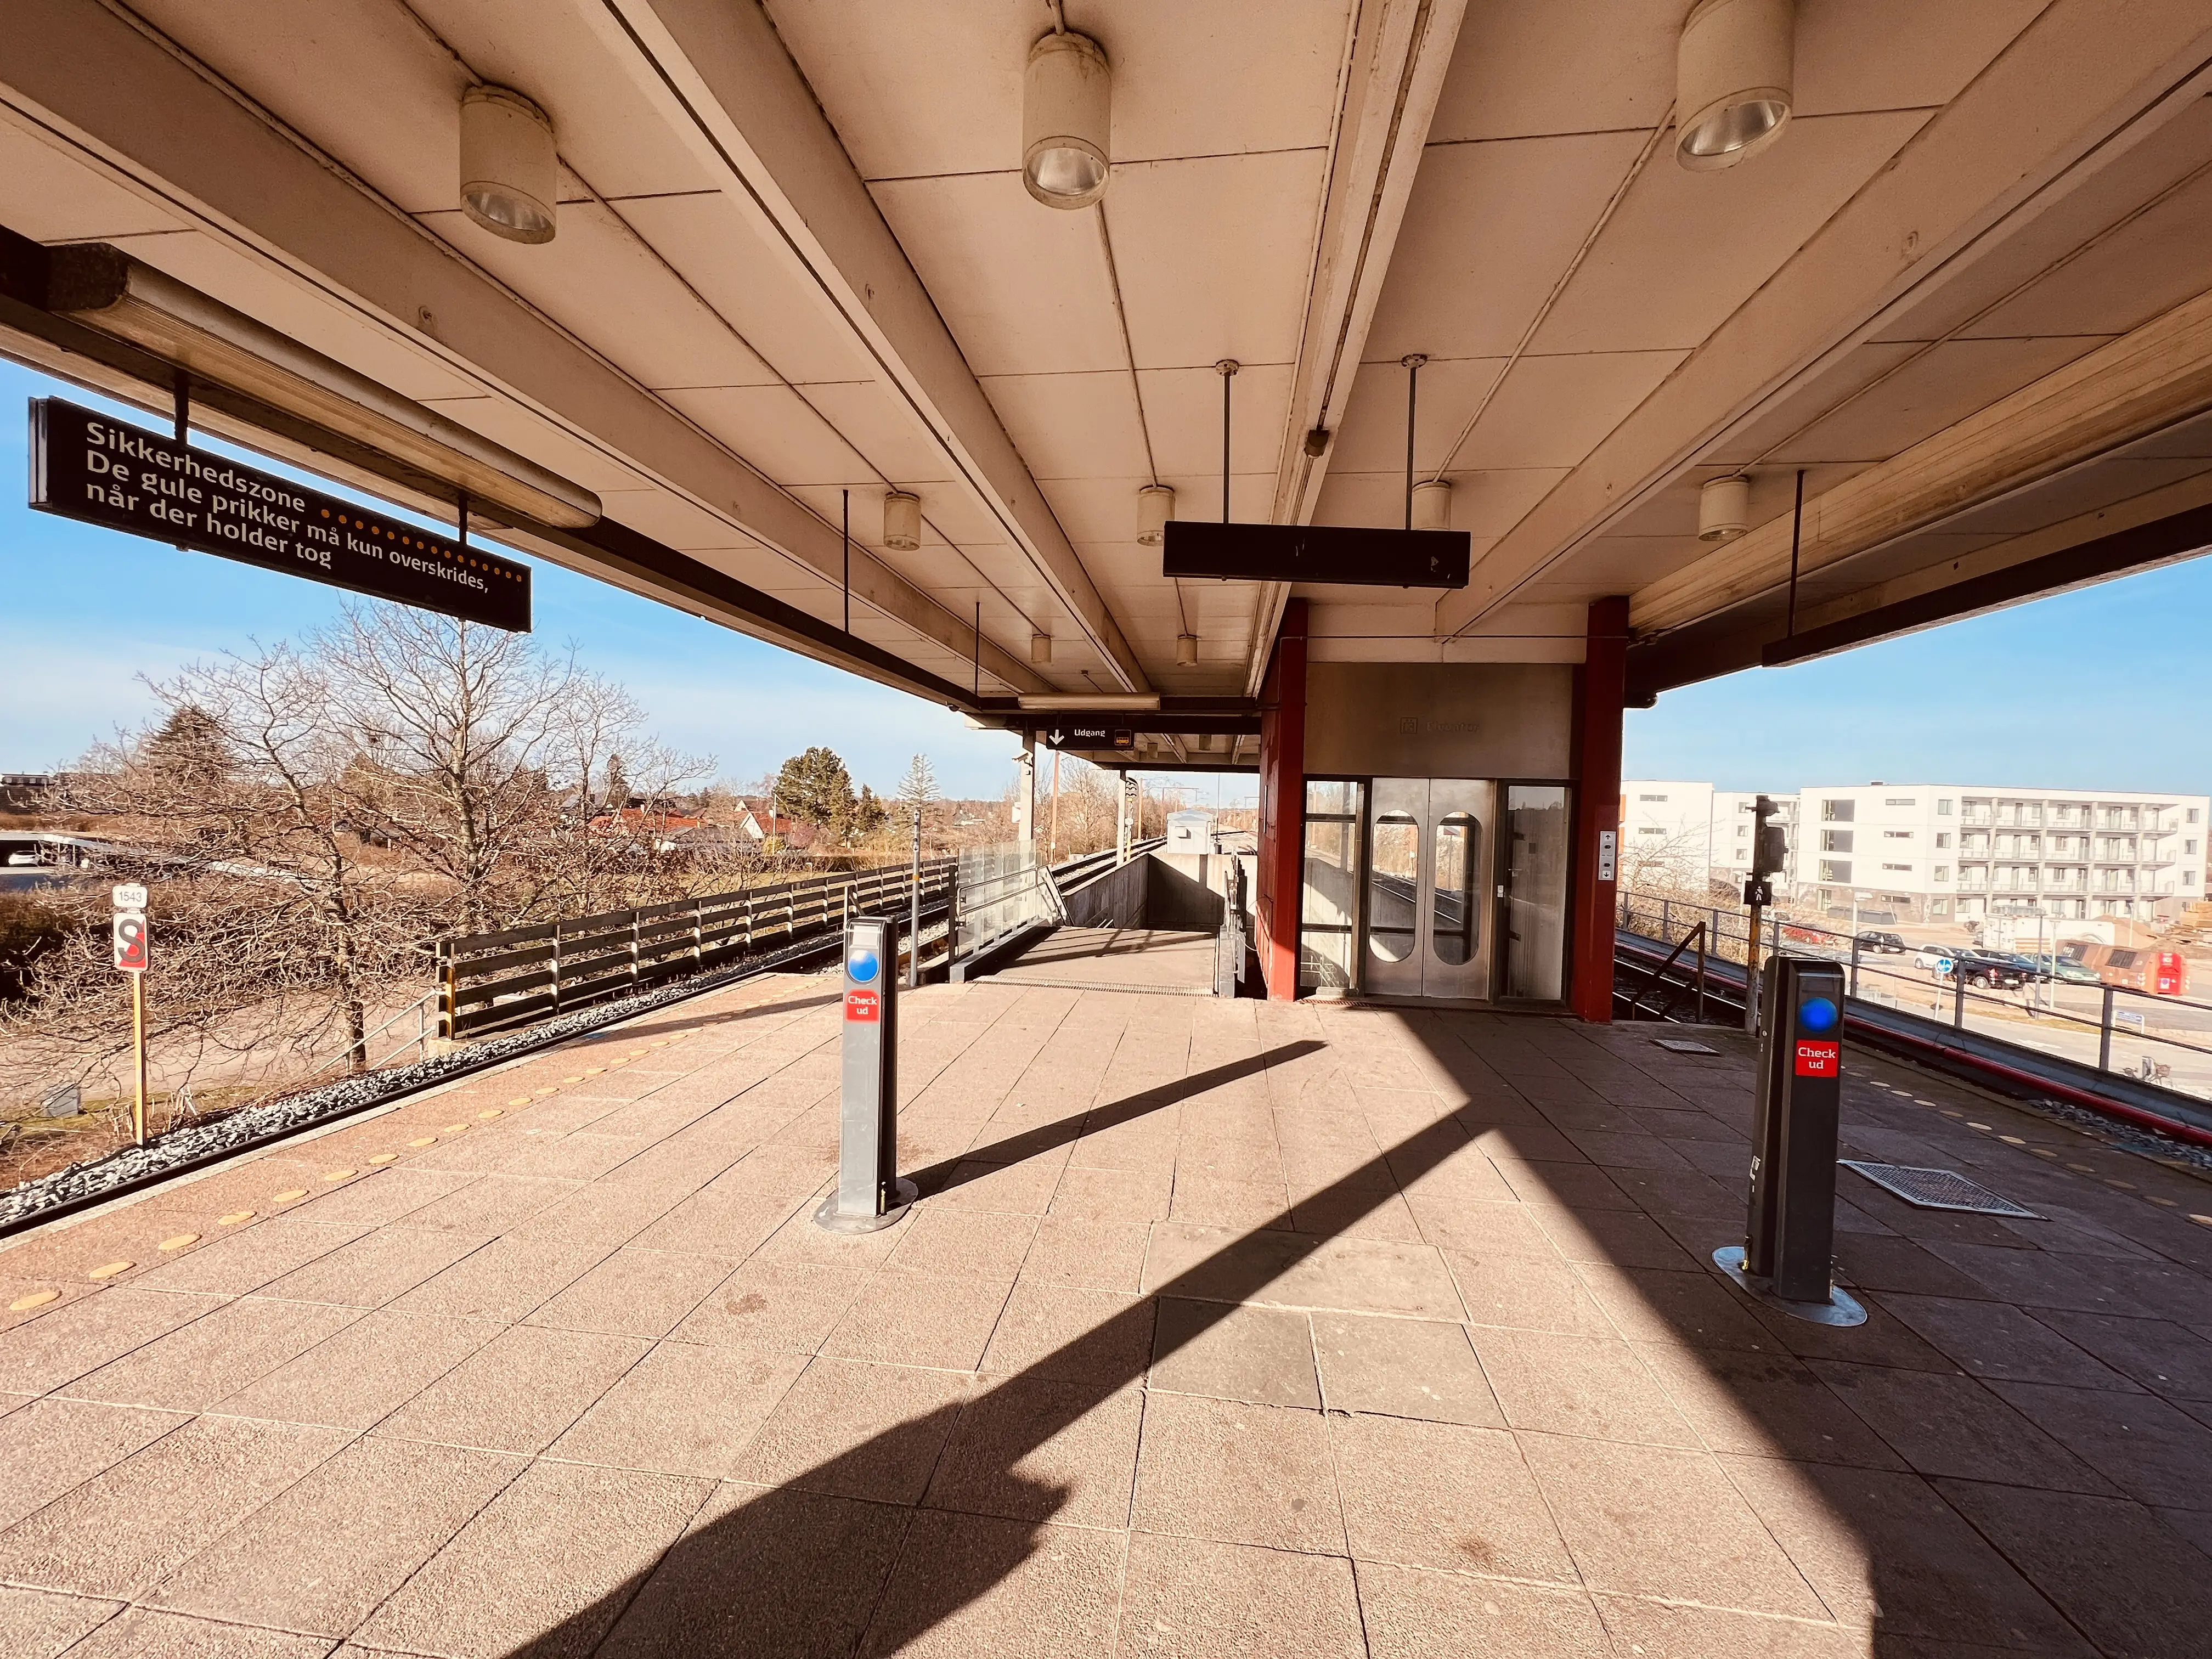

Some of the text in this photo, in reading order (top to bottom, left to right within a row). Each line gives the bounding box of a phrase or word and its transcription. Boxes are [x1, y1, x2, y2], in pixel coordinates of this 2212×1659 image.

[86, 422, 306, 512] Sikkerhedszone
[87, 449, 489, 594] De gule prikker må kun overskrides,
[87, 483, 332, 570] når der holder tog
[1074, 729, 1105, 737] Udgang
[119, 891, 142, 902] 1543
[117, 919, 145, 963] S
[848, 995, 877, 1005] Check
[856, 1007, 868, 1015] ud
[1798, 1047, 1836, 1059] Check
[1808, 1060, 1824, 1069] ud
